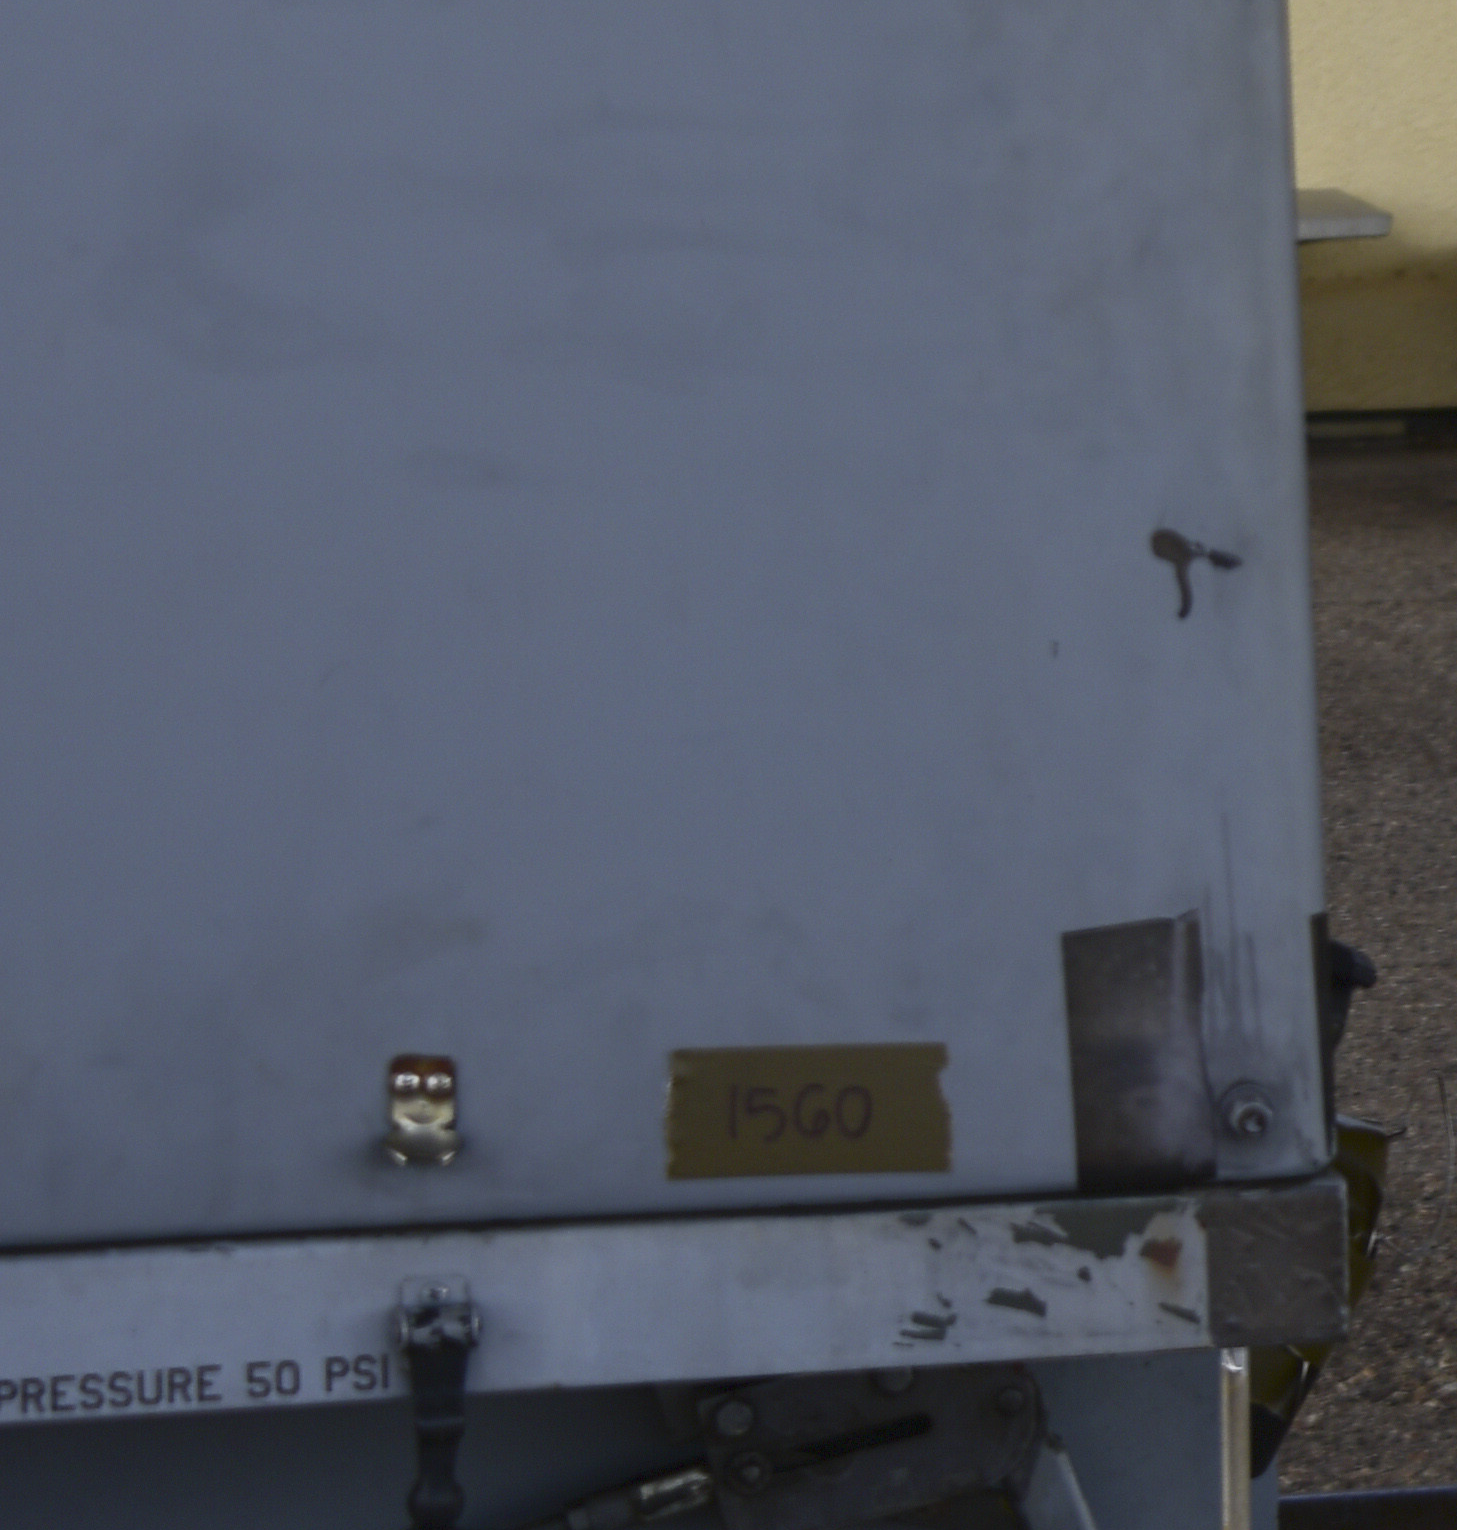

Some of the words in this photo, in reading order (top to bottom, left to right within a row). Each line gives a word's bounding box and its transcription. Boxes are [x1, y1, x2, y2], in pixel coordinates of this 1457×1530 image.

[728, 1083, 873, 1143] 1560
[0, 1364, 223, 1414] PRESSURE
[246, 1359, 301, 1399] 50
[324, 1353, 390, 1393] PSI
